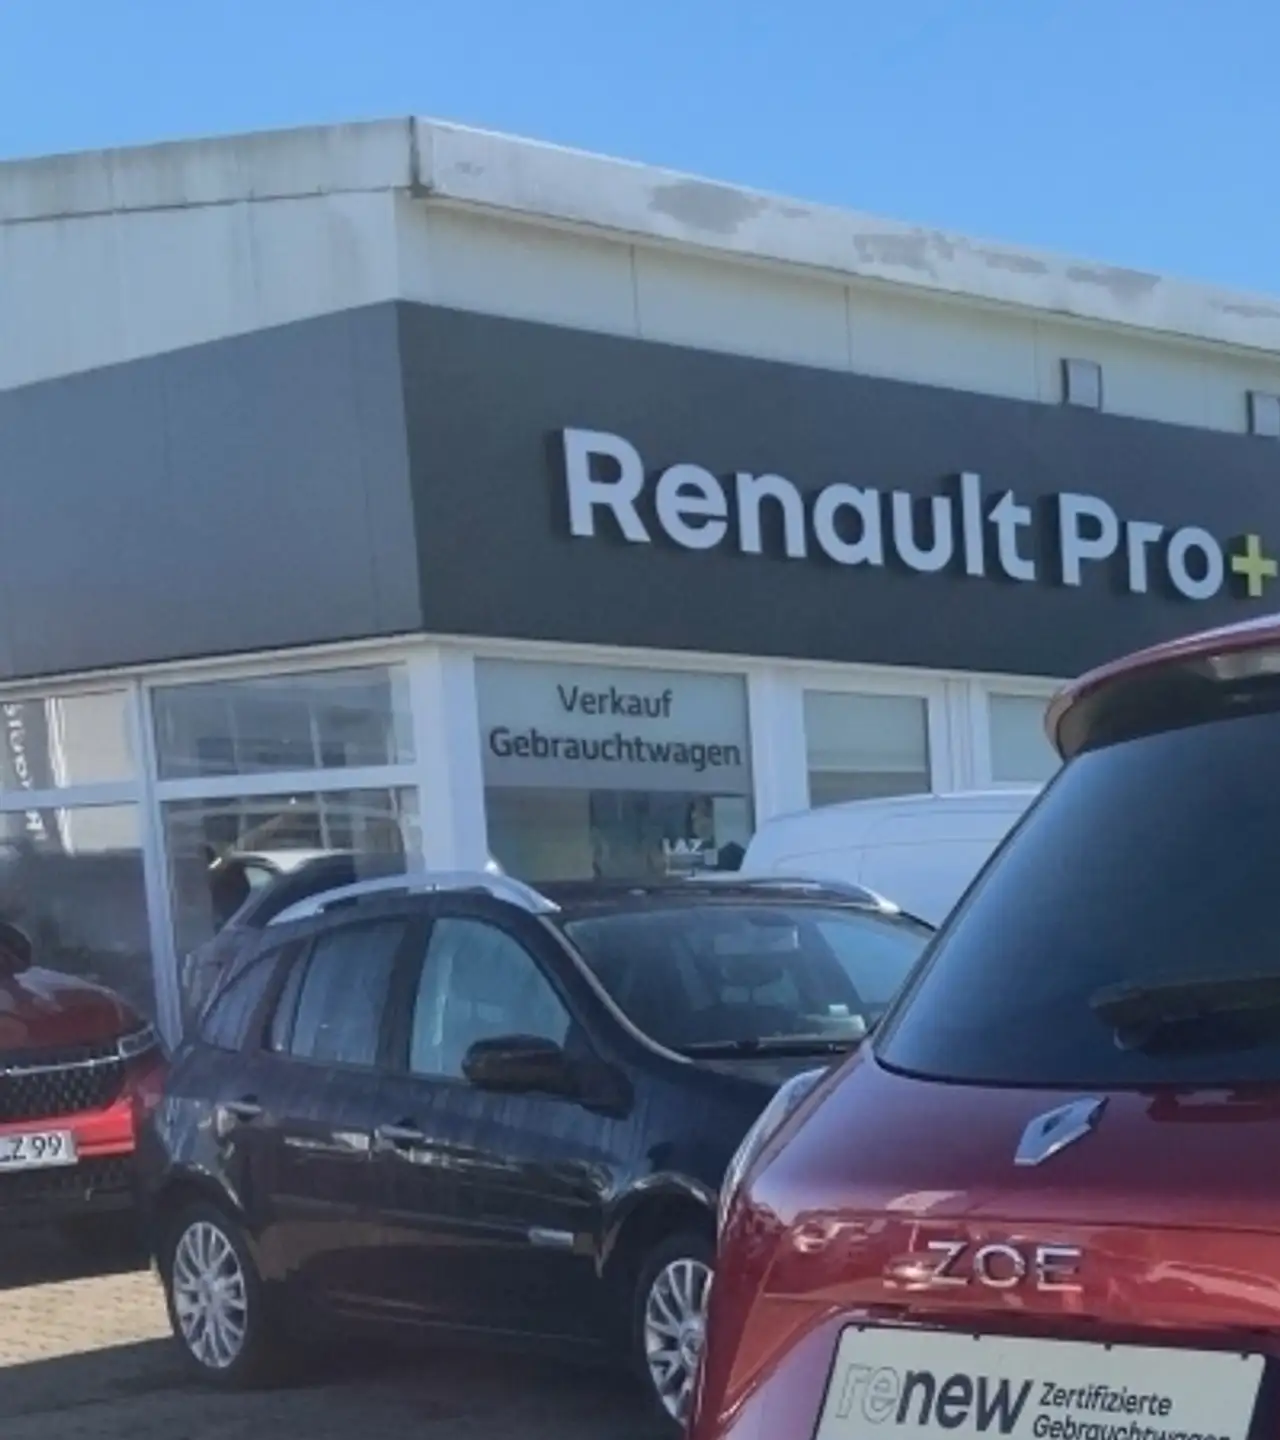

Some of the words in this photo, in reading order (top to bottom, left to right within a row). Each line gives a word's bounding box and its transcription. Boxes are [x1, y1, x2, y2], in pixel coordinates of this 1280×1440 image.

[562, 427, 1037, 581] Renault
[1058, 491, 1278, 600] Pro+
[556, 683, 673, 719] Verkauf
[488, 725, 742, 772] Gebrauchtwagen
[31, 1133, 62, 1158] 99
[927, 1240, 1084, 1292] ZOE
[835, 1362, 1034, 1434] renew
[1038, 1381, 1173, 1417] Zertifizierte
